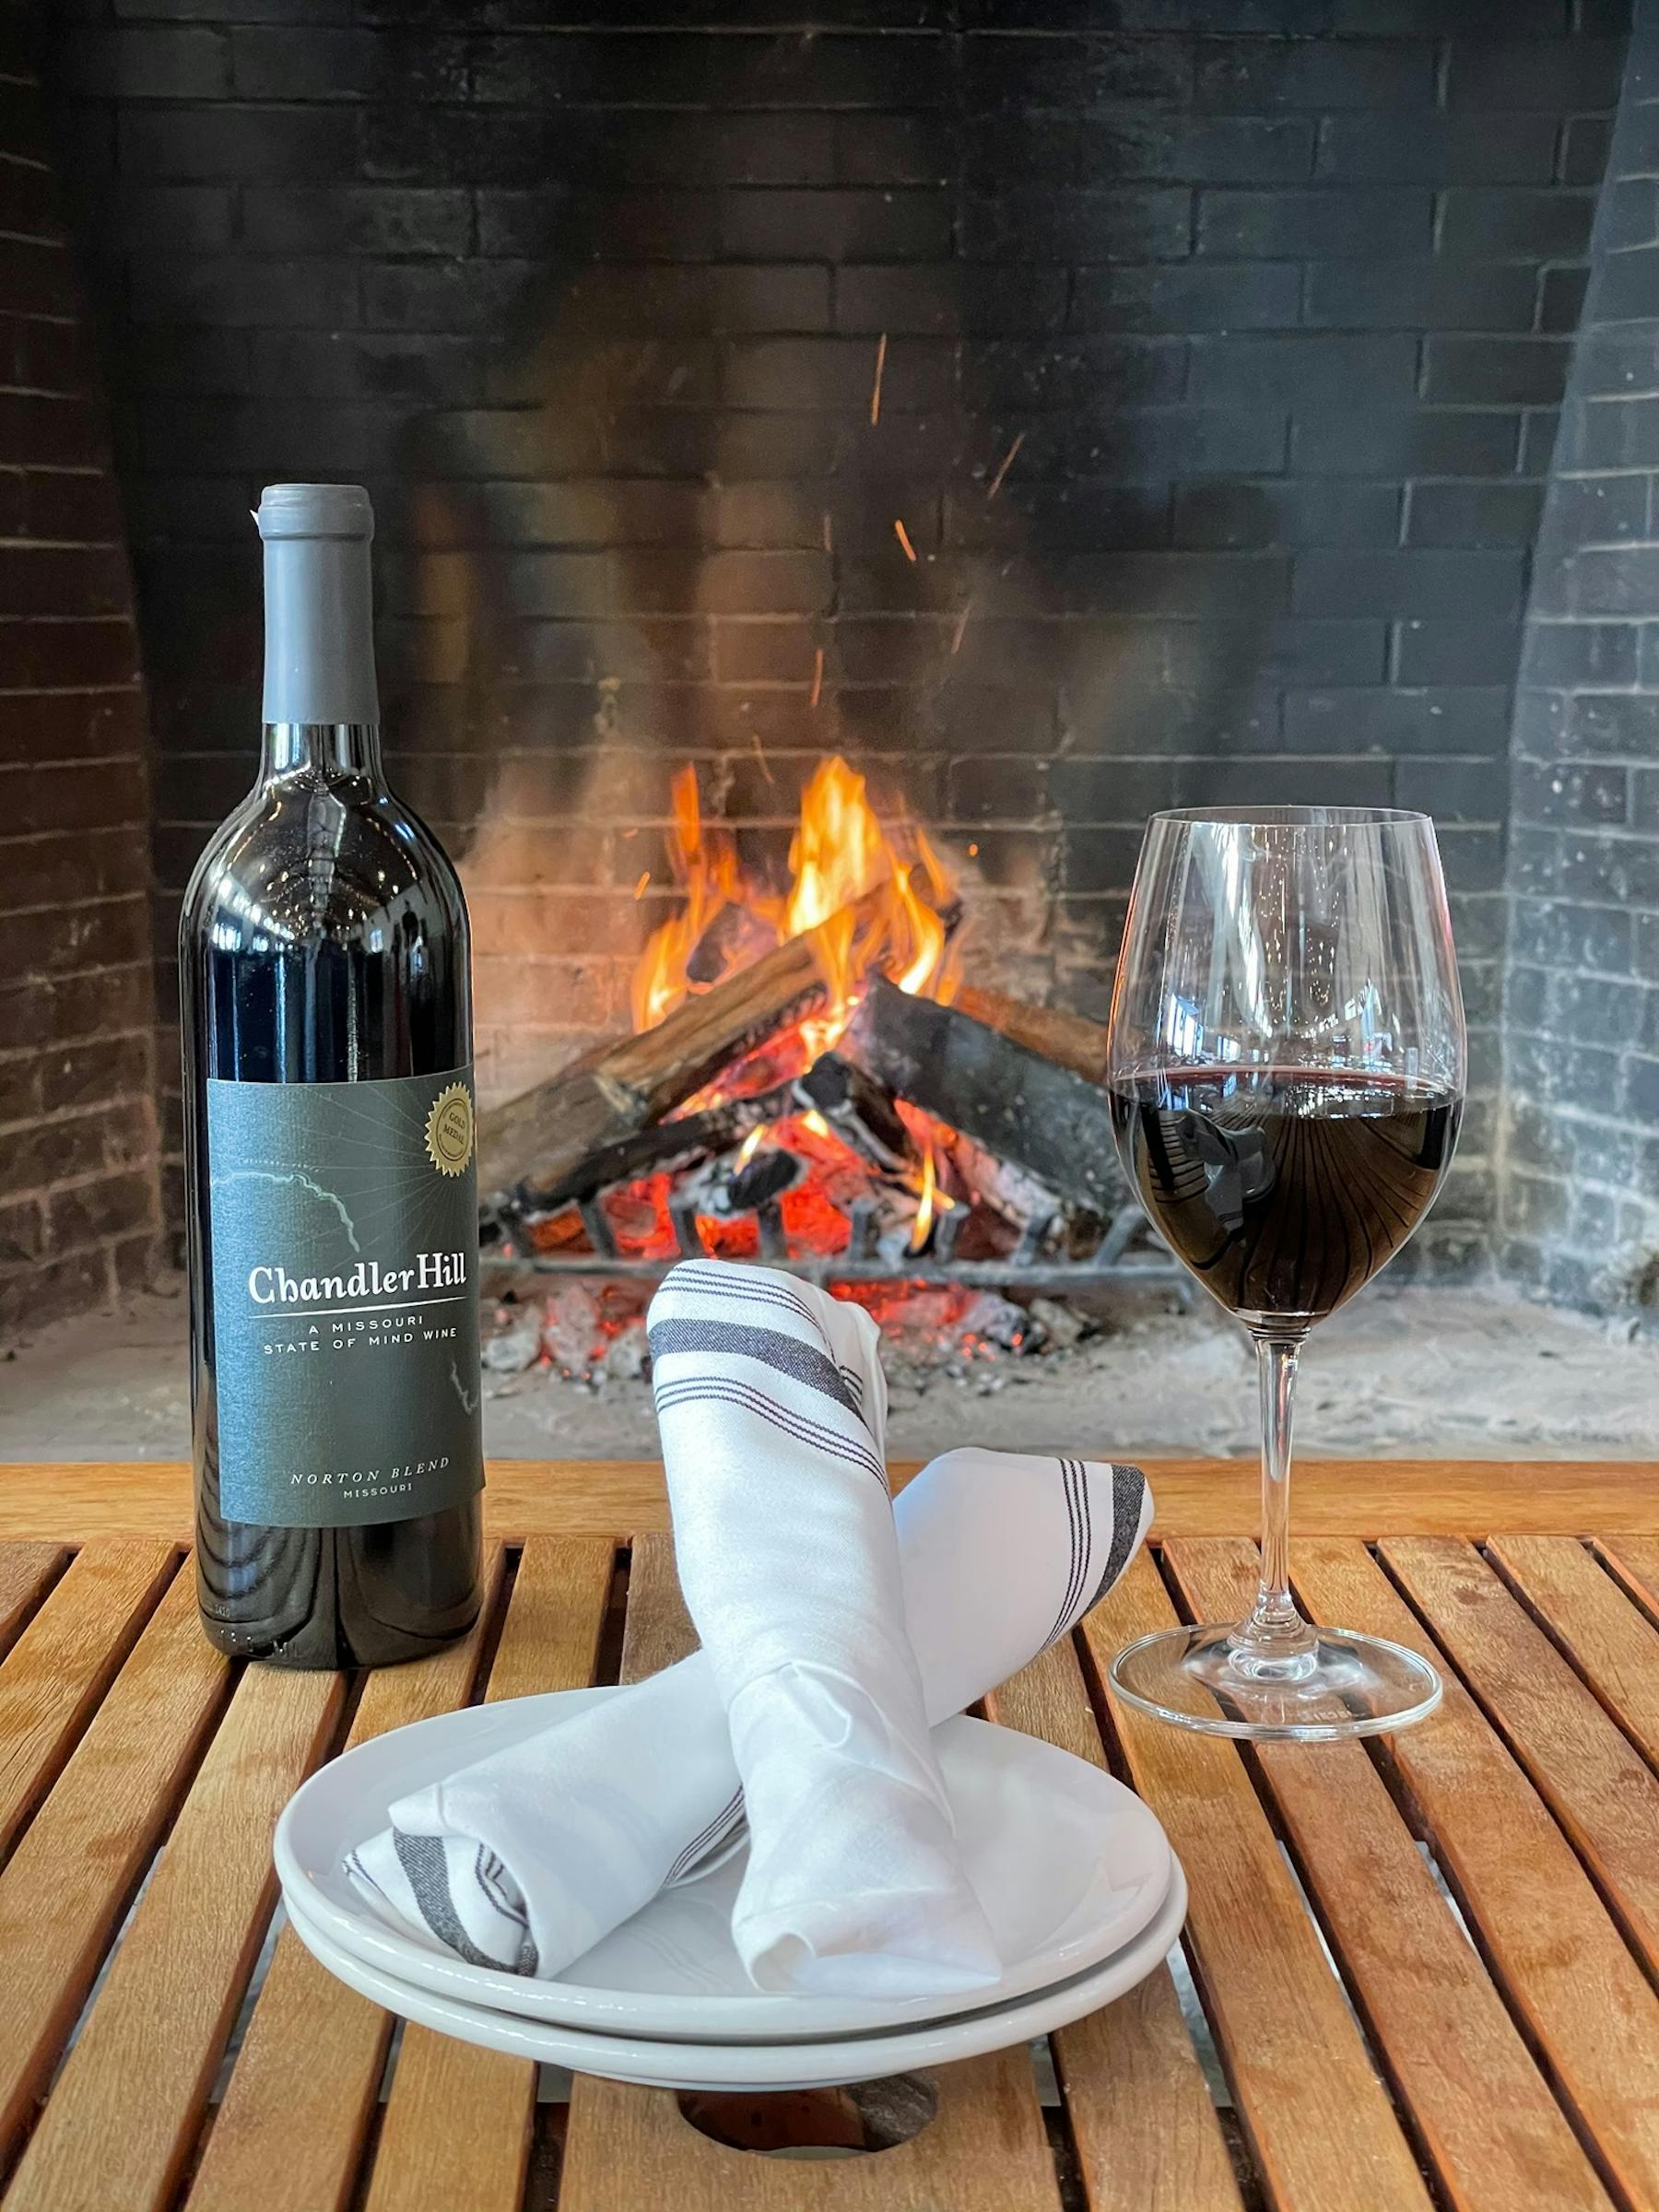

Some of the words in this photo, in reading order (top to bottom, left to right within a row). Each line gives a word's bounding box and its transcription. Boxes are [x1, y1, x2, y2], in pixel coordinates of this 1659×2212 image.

[309, 1325, 320, 1335] A
[332, 1315, 423, 1333] MISSOURI
[264, 1341, 320, 1355] STATE
[333, 1338, 356, 1350] OF
[369, 1334, 414, 1346] MIND
[423, 1327, 457, 1341] WINE
[290, 1470, 380, 1485] NORTON
[391, 1457, 450, 1479] BLEND
[343, 1482, 413, 1499] MISSOURI
